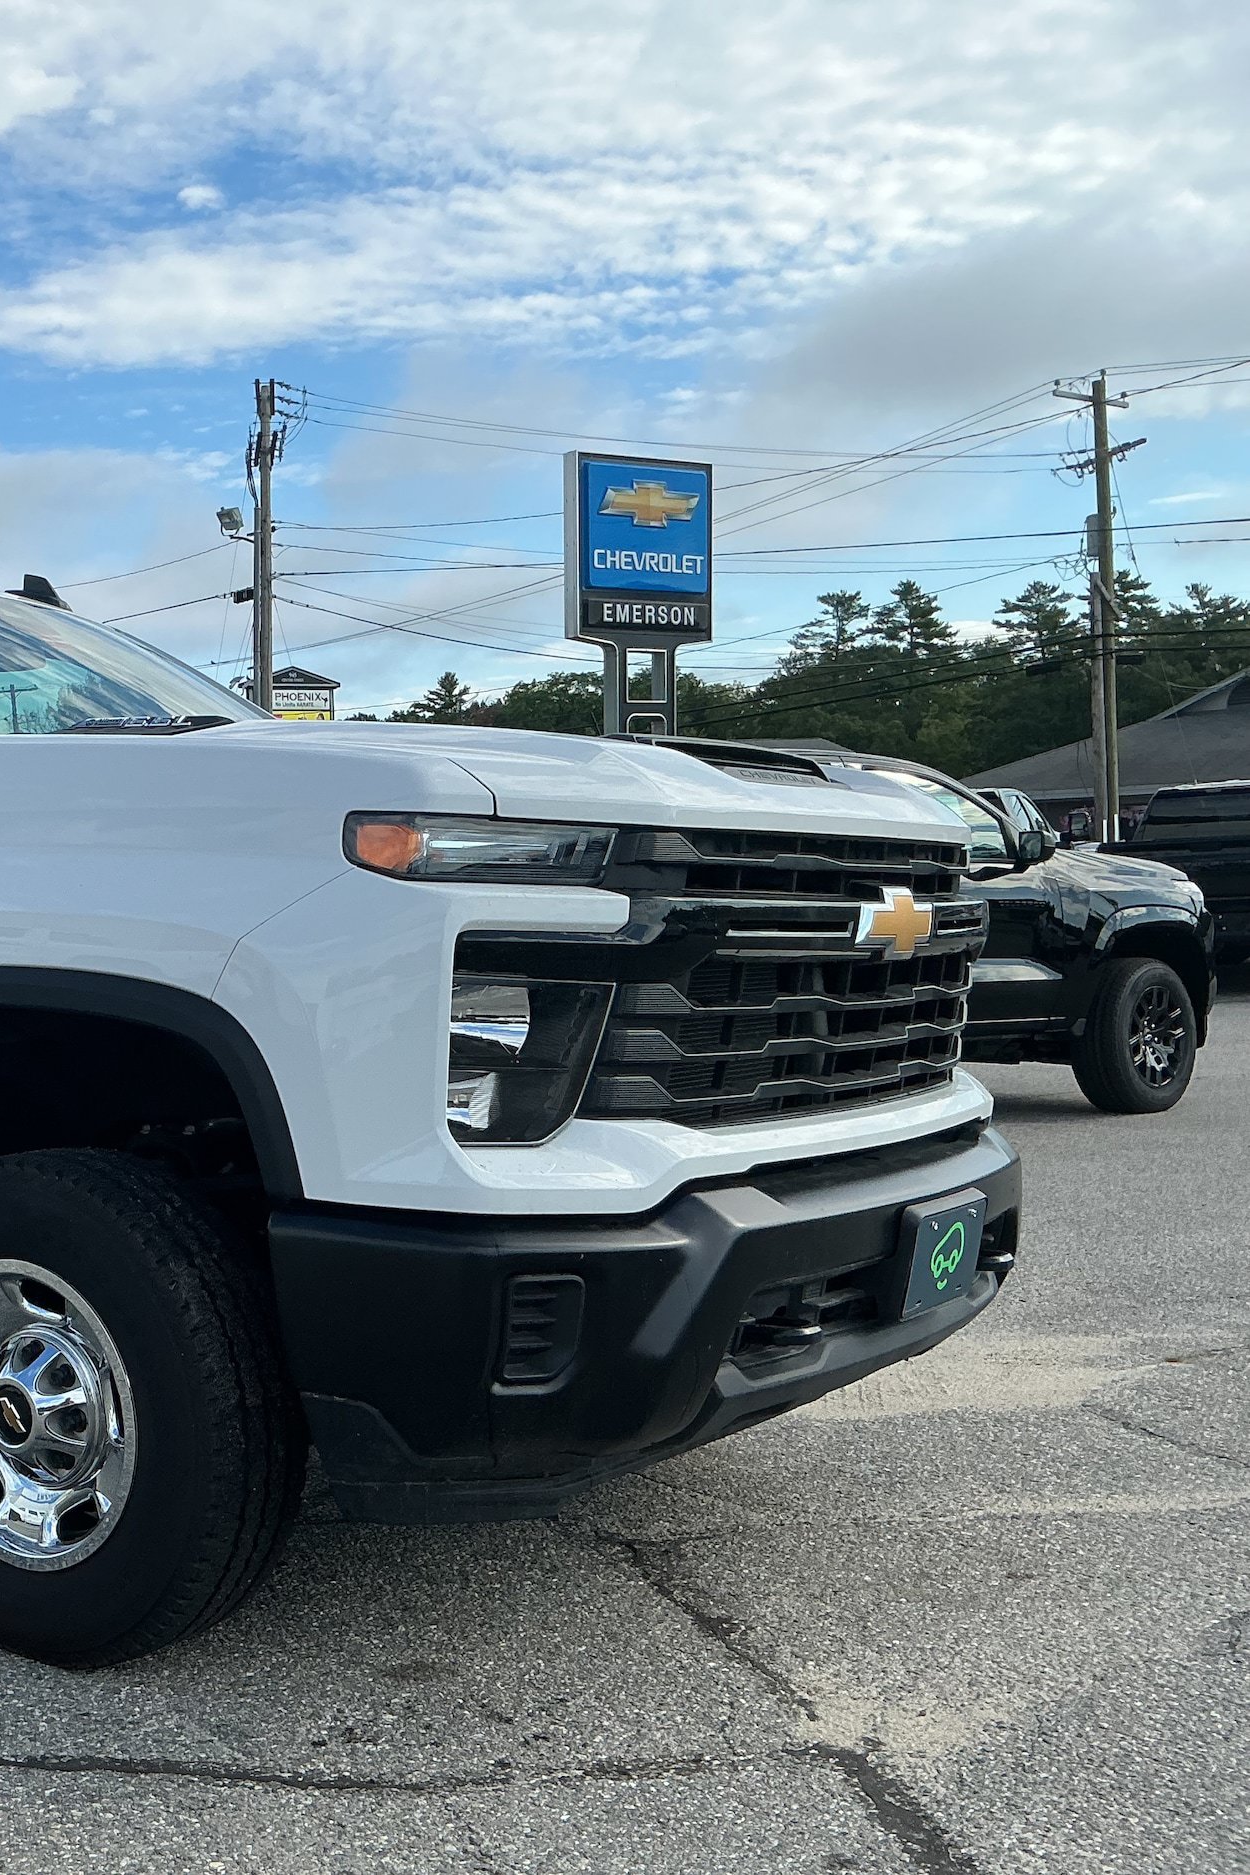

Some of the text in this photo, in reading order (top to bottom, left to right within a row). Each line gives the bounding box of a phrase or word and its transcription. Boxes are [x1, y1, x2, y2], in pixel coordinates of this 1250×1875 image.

[593, 549, 705, 575] CHEVROLET
[602, 602, 696, 627] EMERSON
[275, 692, 321, 701] PHOENIX
